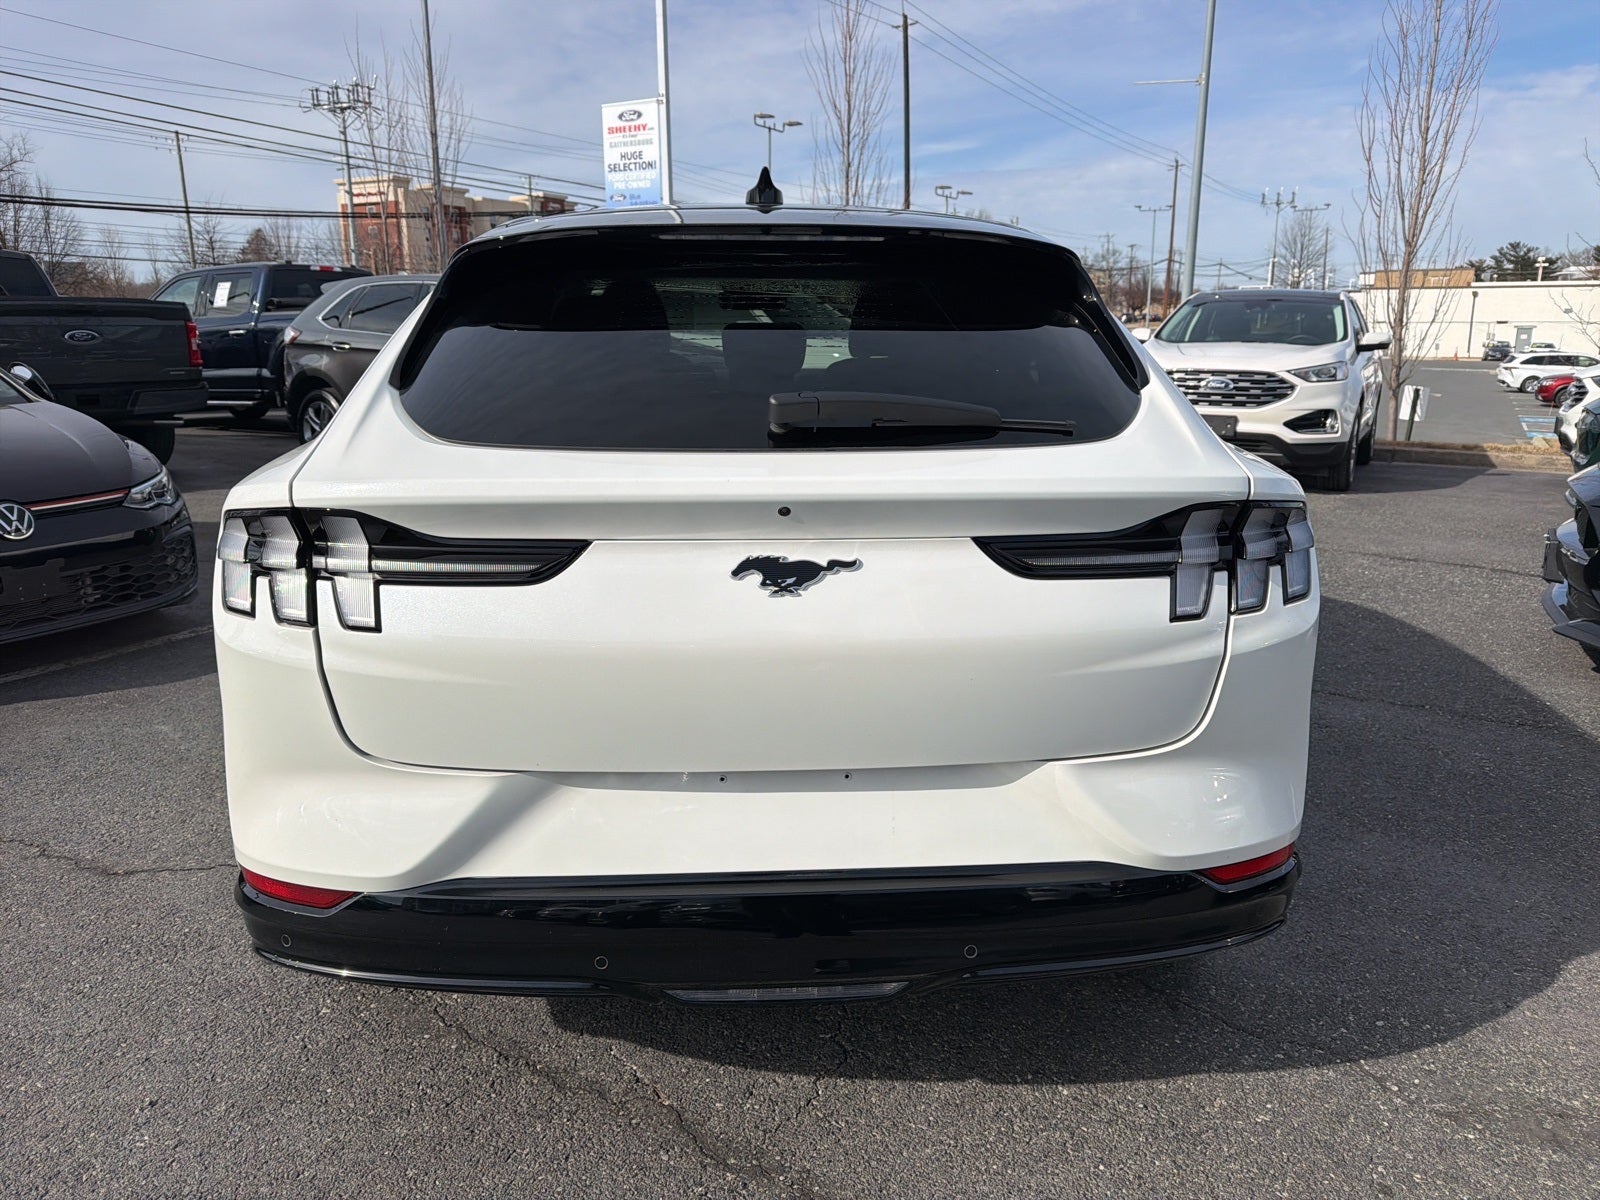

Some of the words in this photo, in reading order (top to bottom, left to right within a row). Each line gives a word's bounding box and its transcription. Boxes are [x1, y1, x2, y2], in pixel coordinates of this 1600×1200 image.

[607, 123, 648, 135] SHEEHY
[620, 150, 644, 162] HUGE
[607, 160, 657, 173] SELECTION!
